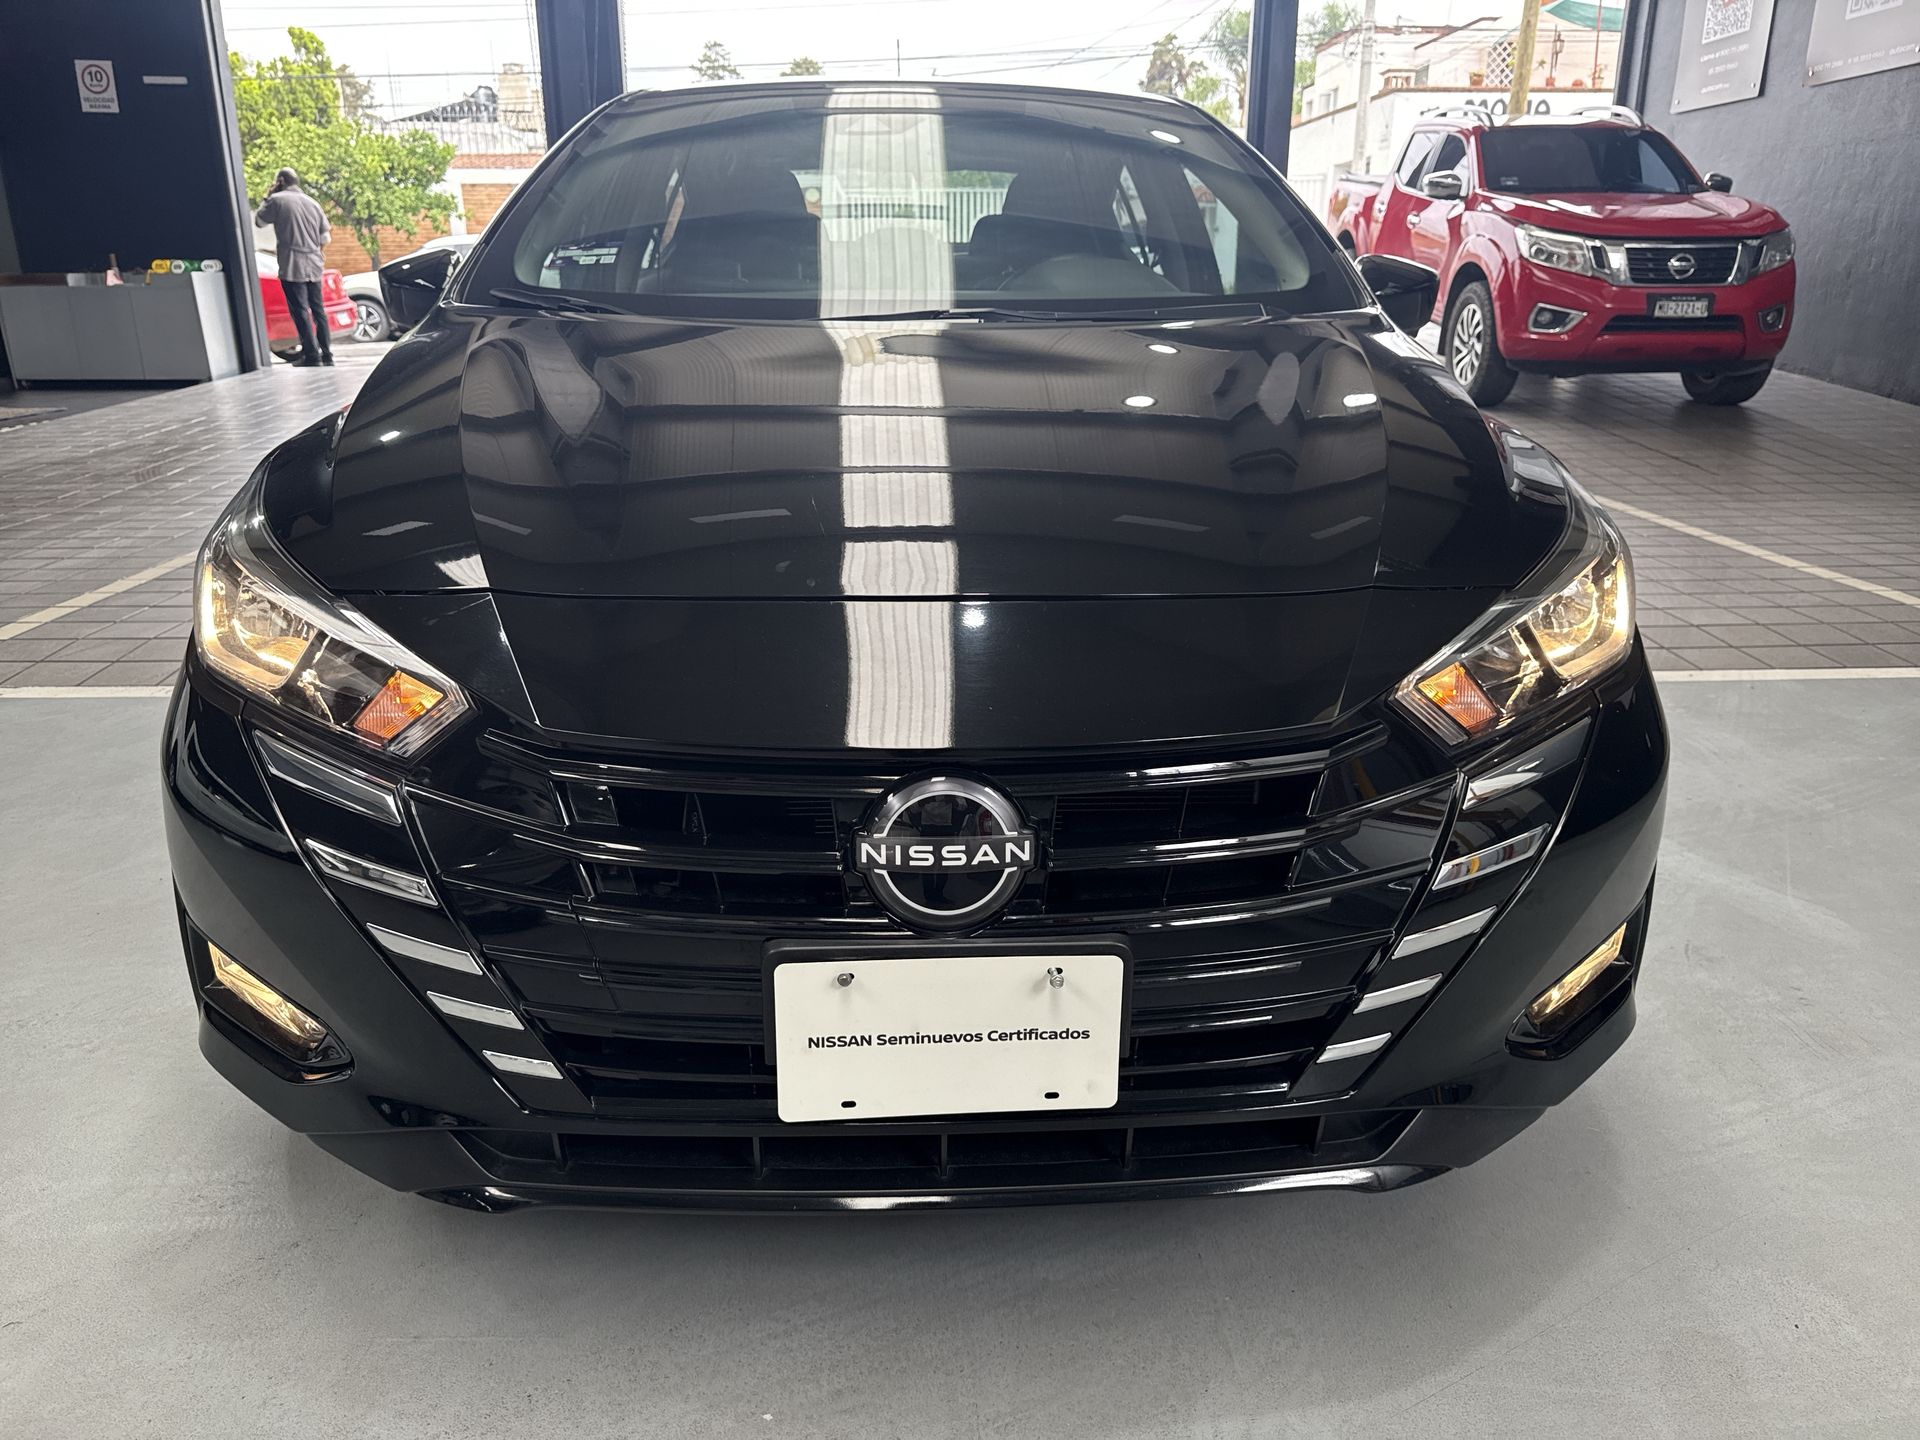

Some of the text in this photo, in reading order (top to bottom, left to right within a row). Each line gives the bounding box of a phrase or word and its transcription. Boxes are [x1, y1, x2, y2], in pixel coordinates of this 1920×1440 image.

[87, 70, 103, 83] 10
[860, 840, 1031, 867] NISSAN
[808, 1027, 1091, 1049] NISSAN Seminuevos Certificados
